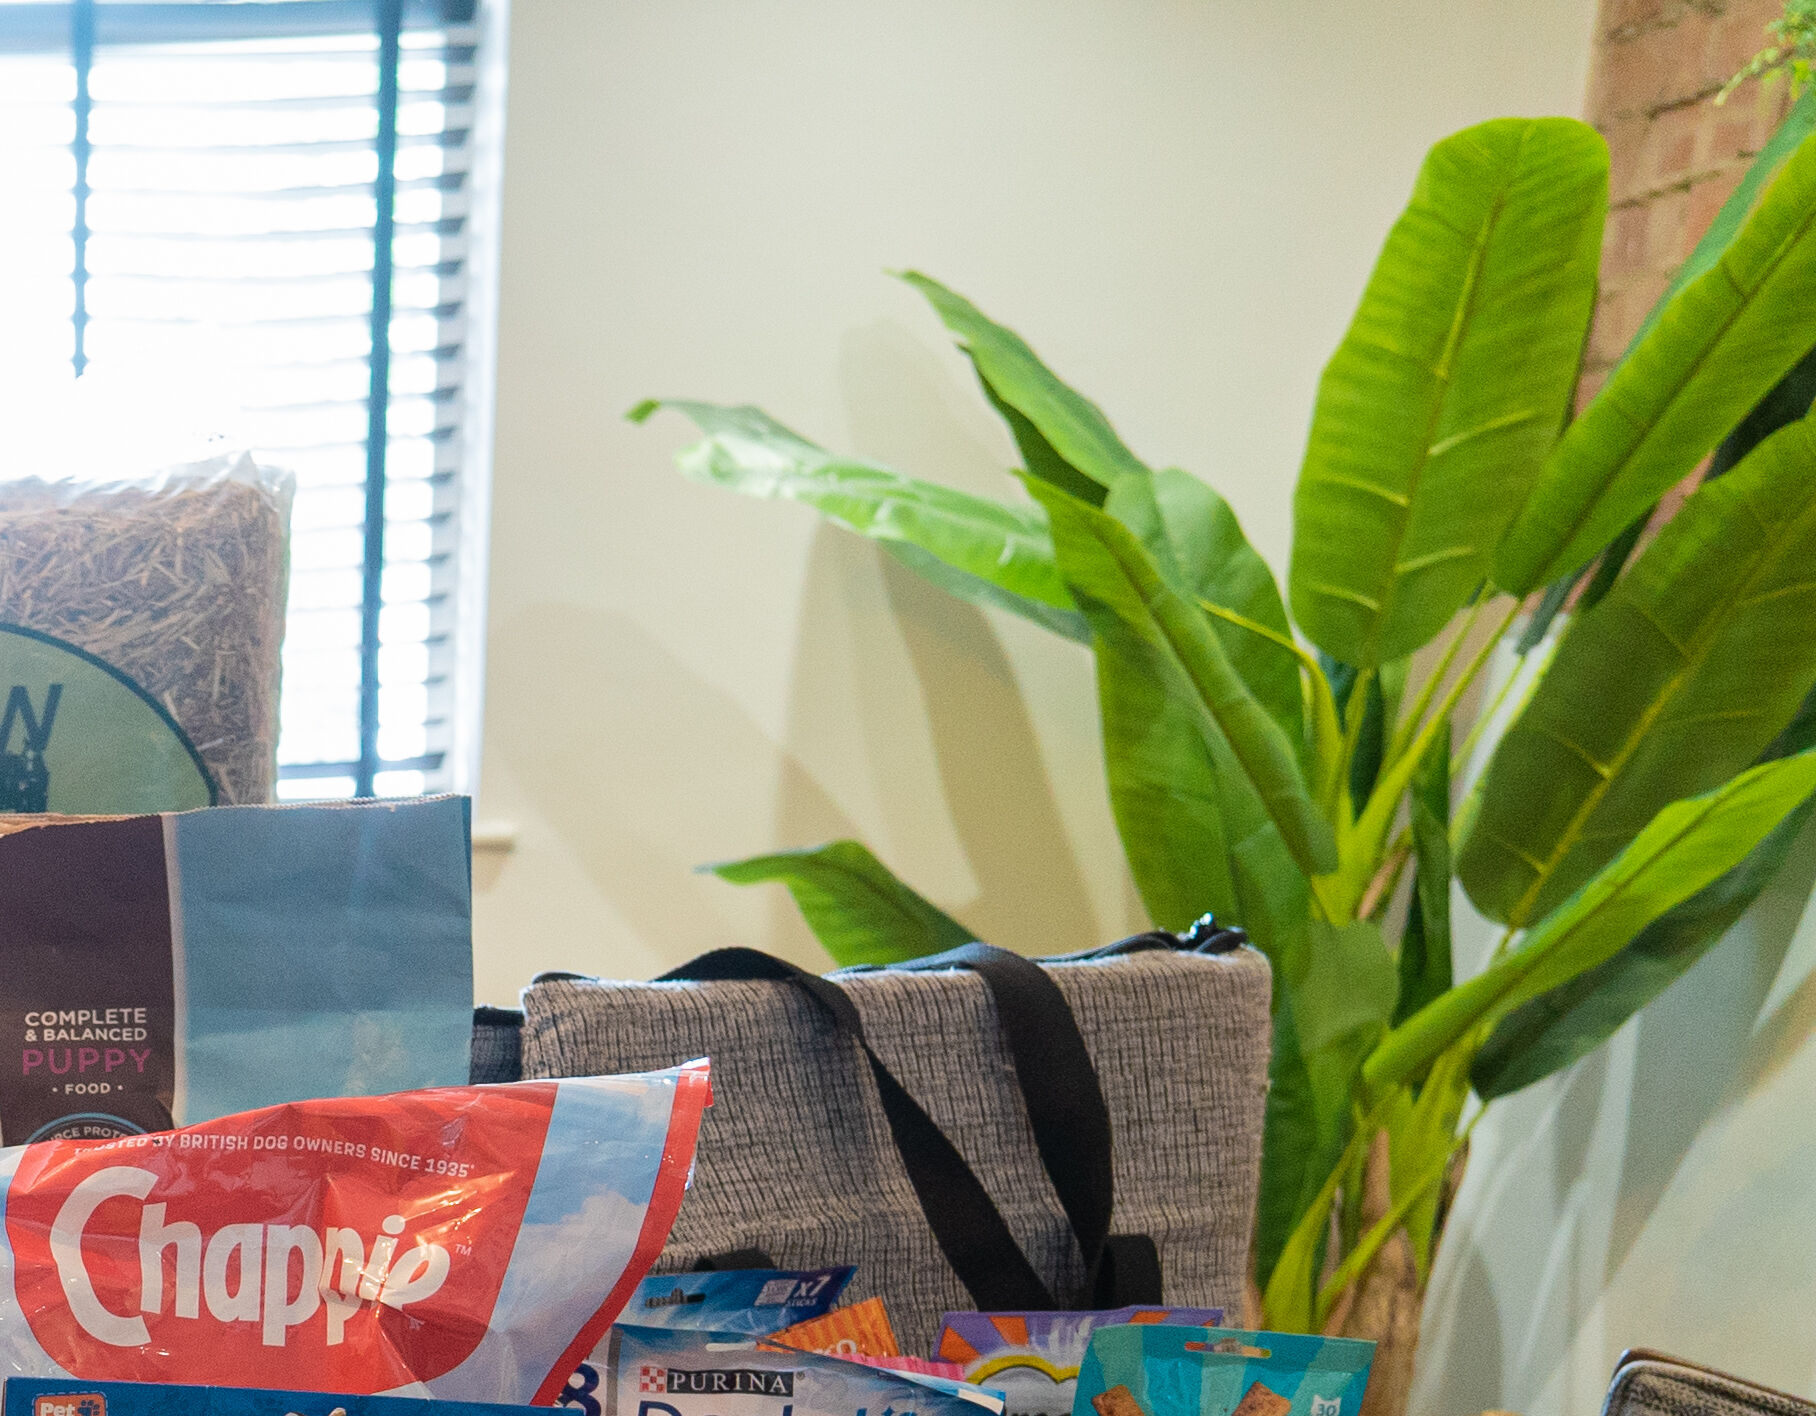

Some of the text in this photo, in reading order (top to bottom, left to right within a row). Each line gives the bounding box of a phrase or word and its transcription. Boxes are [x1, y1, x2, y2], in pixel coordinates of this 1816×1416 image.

[24, 1008, 147, 1026] COMPLETE
[24, 1028, 147, 1042] & BALANCED
[22, 1047, 152, 1076] PUPPY
[64, 1083, 112, 1096] FOOD
[179, 1134, 248, 1150] BRITISH
[252, 1136, 289, 1151] DOG
[292, 1136, 366, 1159] OWNERS
[370, 1147, 421, 1171] SINCE
[49, 1165, 452, 1347] Chappie
[671, 1372, 789, 1394] PURINA
